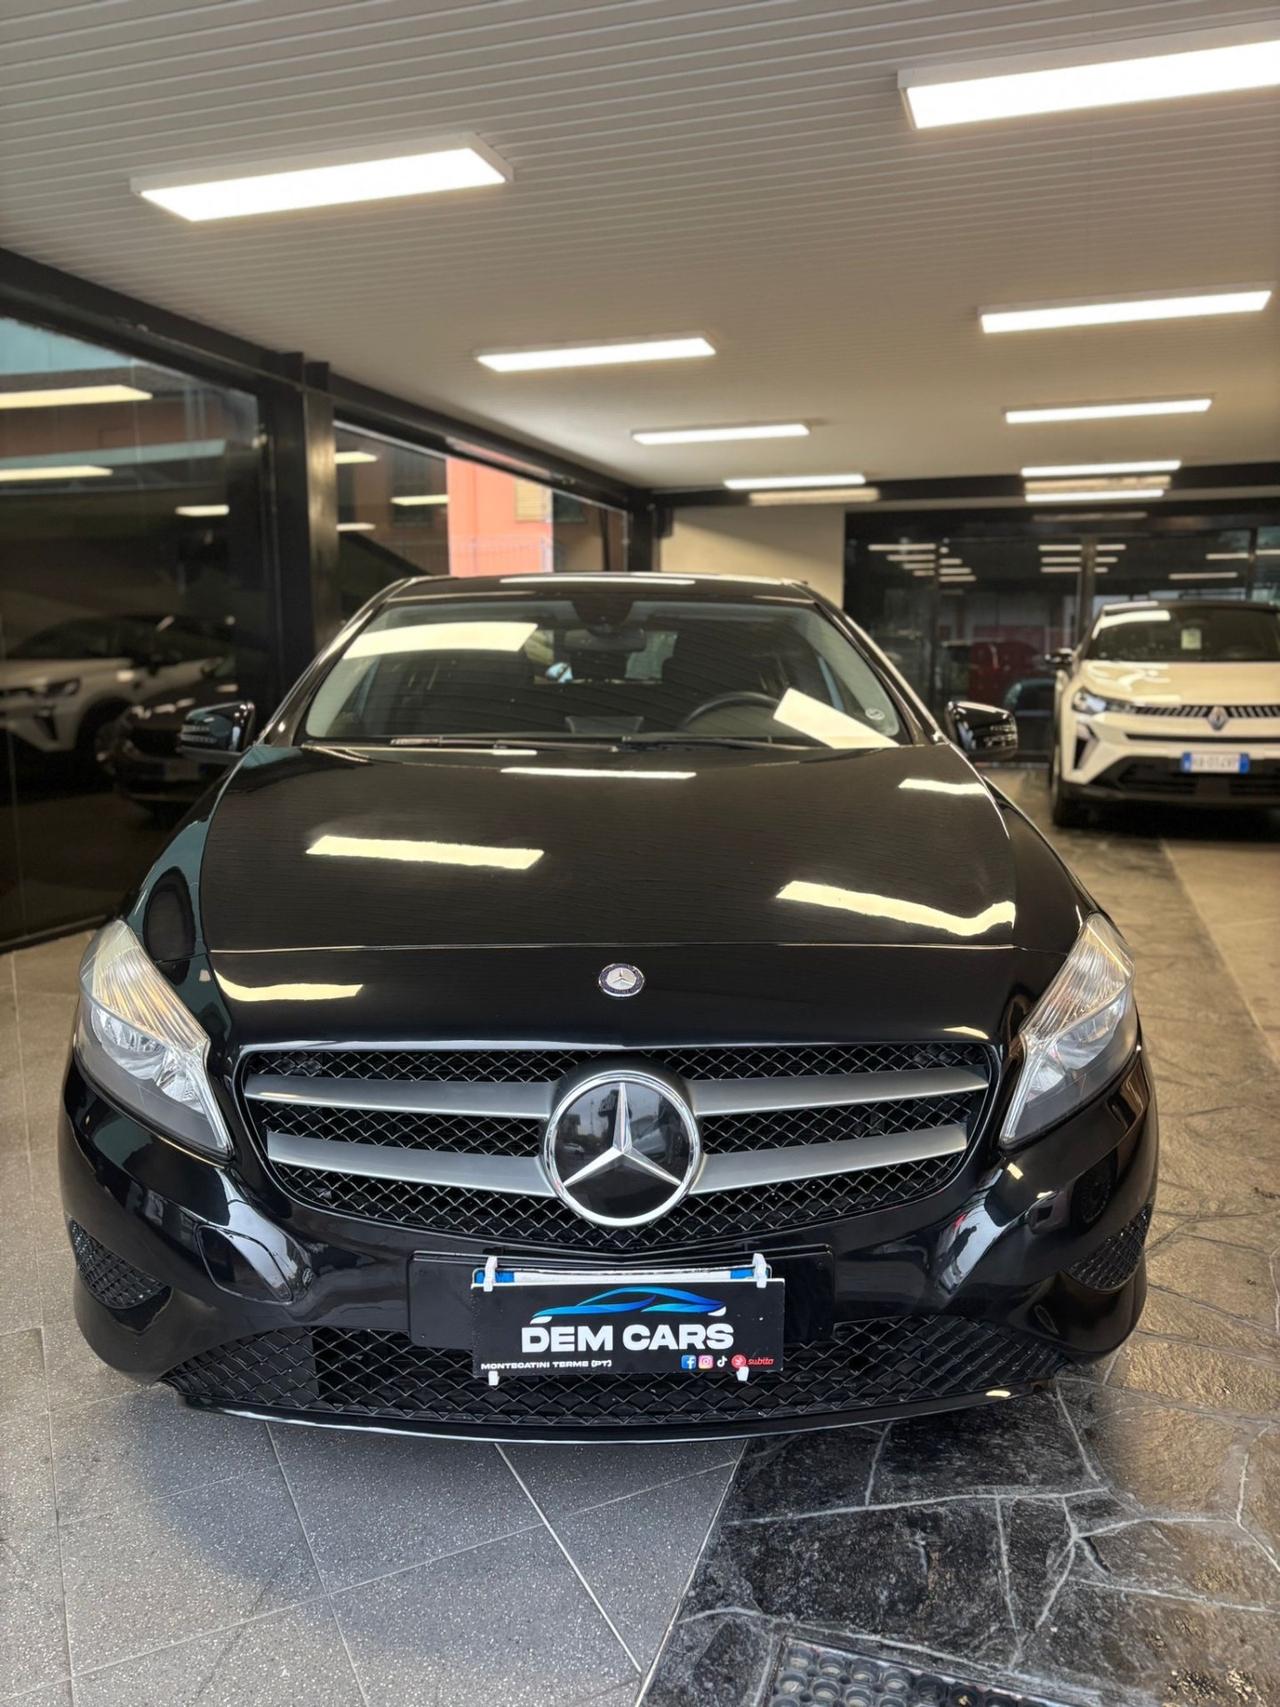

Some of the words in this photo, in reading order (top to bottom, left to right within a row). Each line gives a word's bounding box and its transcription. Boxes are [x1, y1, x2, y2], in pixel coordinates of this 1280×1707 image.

[521, 1325, 614, 1353] DEM
[622, 1323, 734, 1351] CARS
[481, 1361, 550, 1370] MONTECATINI
[552, 1360, 589, 1369] TERME
[591, 1359, 612, 1368] (PT)
[747, 1356, 774, 1366] subito
